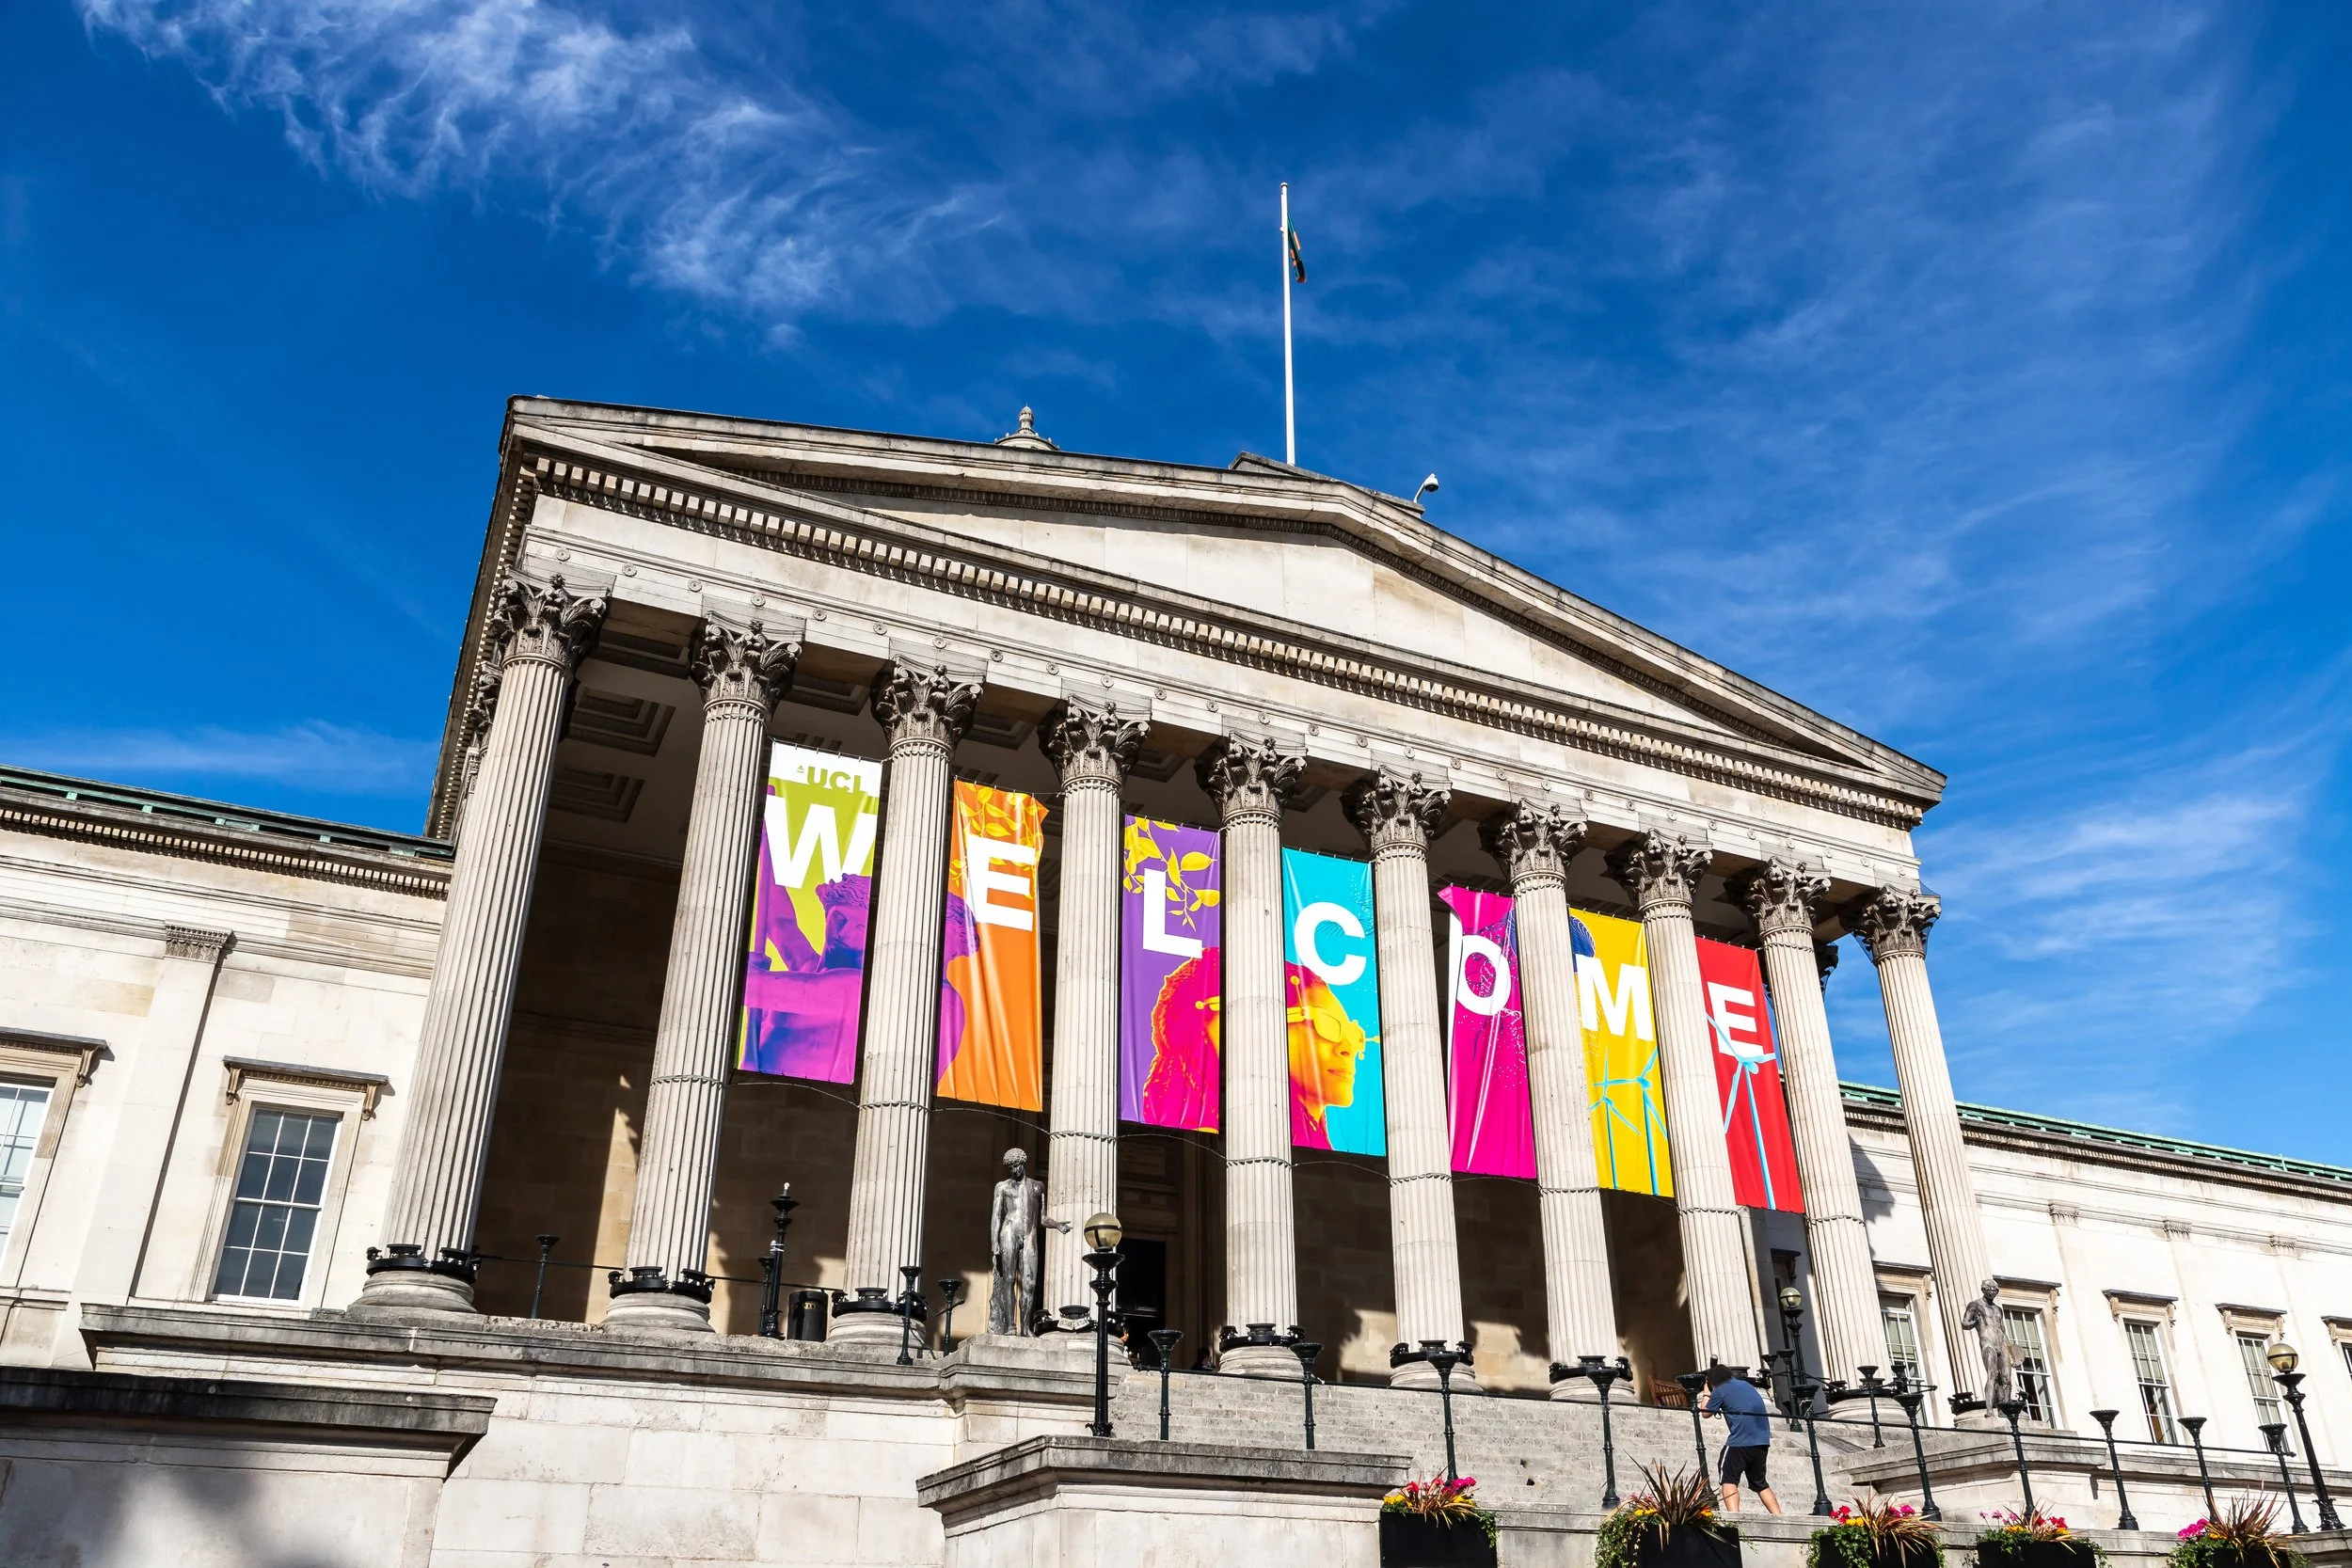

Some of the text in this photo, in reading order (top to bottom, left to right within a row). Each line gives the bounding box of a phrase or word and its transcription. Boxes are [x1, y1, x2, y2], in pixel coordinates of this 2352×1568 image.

[764, 795, 879, 889] W
[967, 834, 1036, 931] E
[1143, 868, 1202, 959] L
[1295, 901, 1367, 986] C
[1455, 934, 1512, 1016] O
[1575, 953, 1654, 1041] M
[1707, 981, 1764, 1057] E
